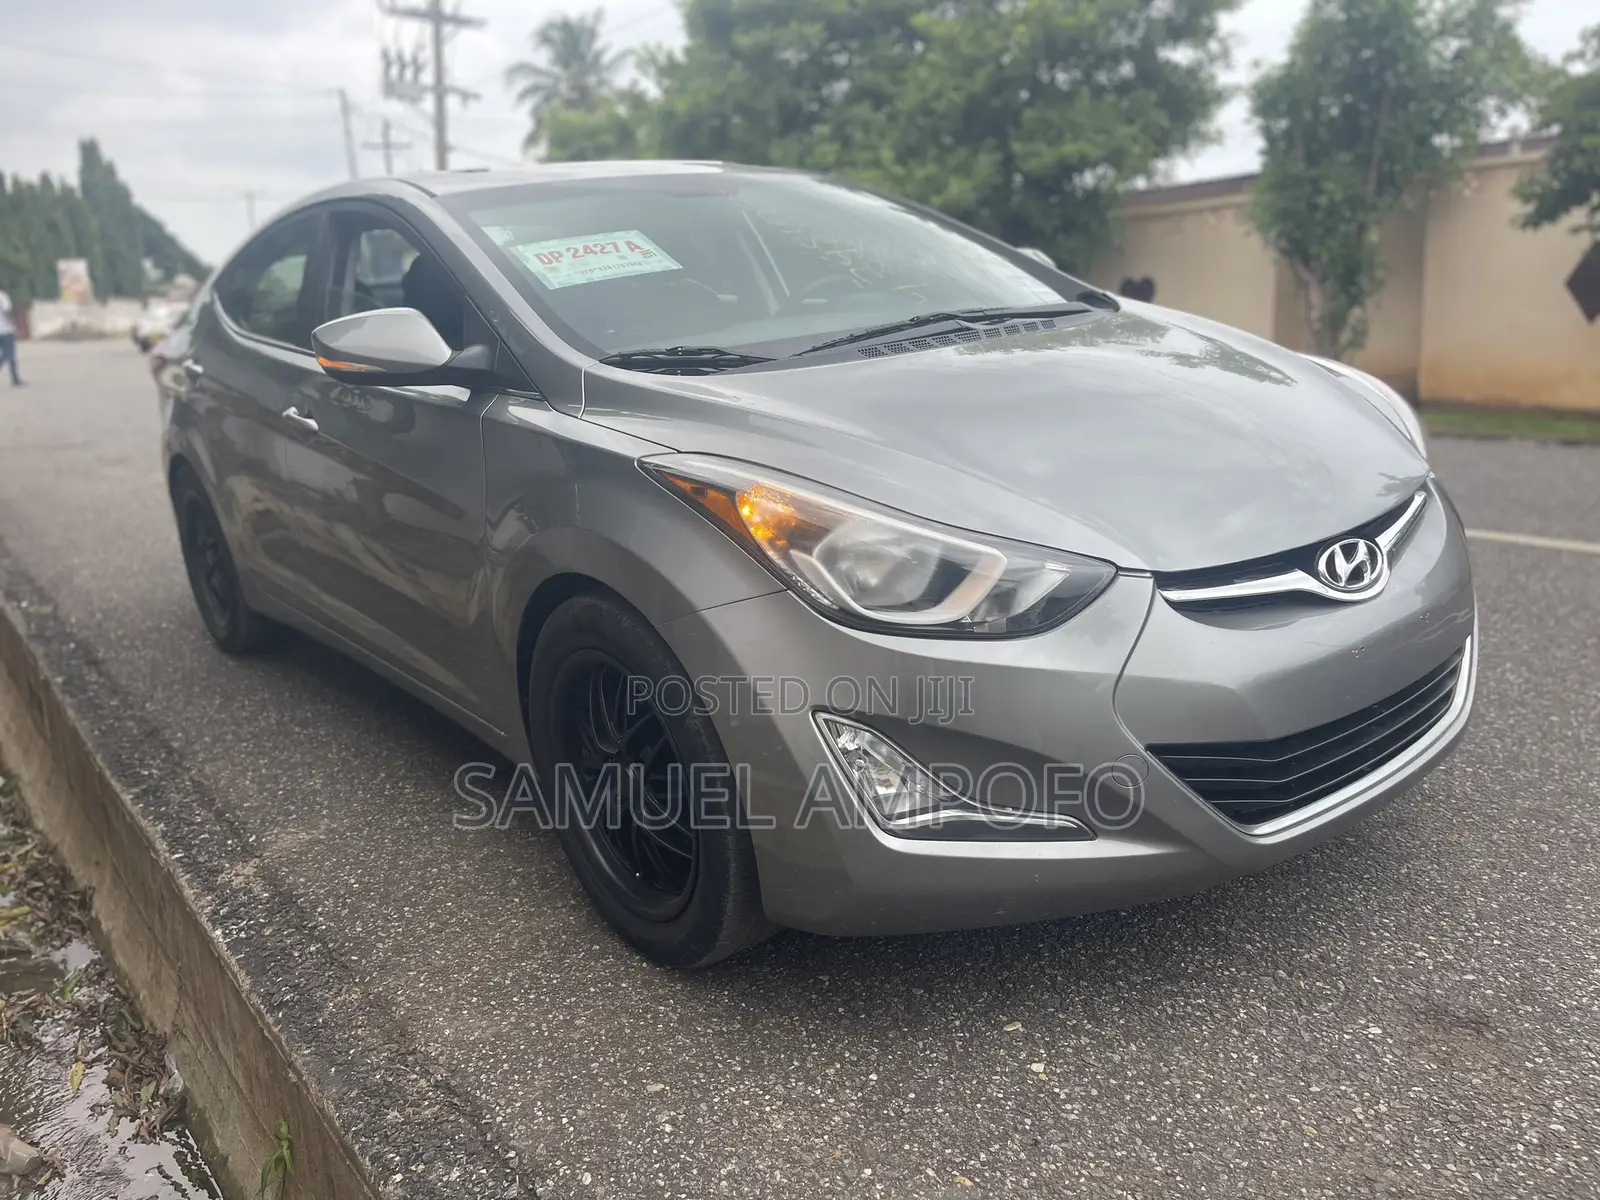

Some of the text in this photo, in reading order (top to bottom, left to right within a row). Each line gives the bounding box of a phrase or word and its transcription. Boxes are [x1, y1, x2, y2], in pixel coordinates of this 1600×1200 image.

[534, 240, 644, 265] DP 2427 A
